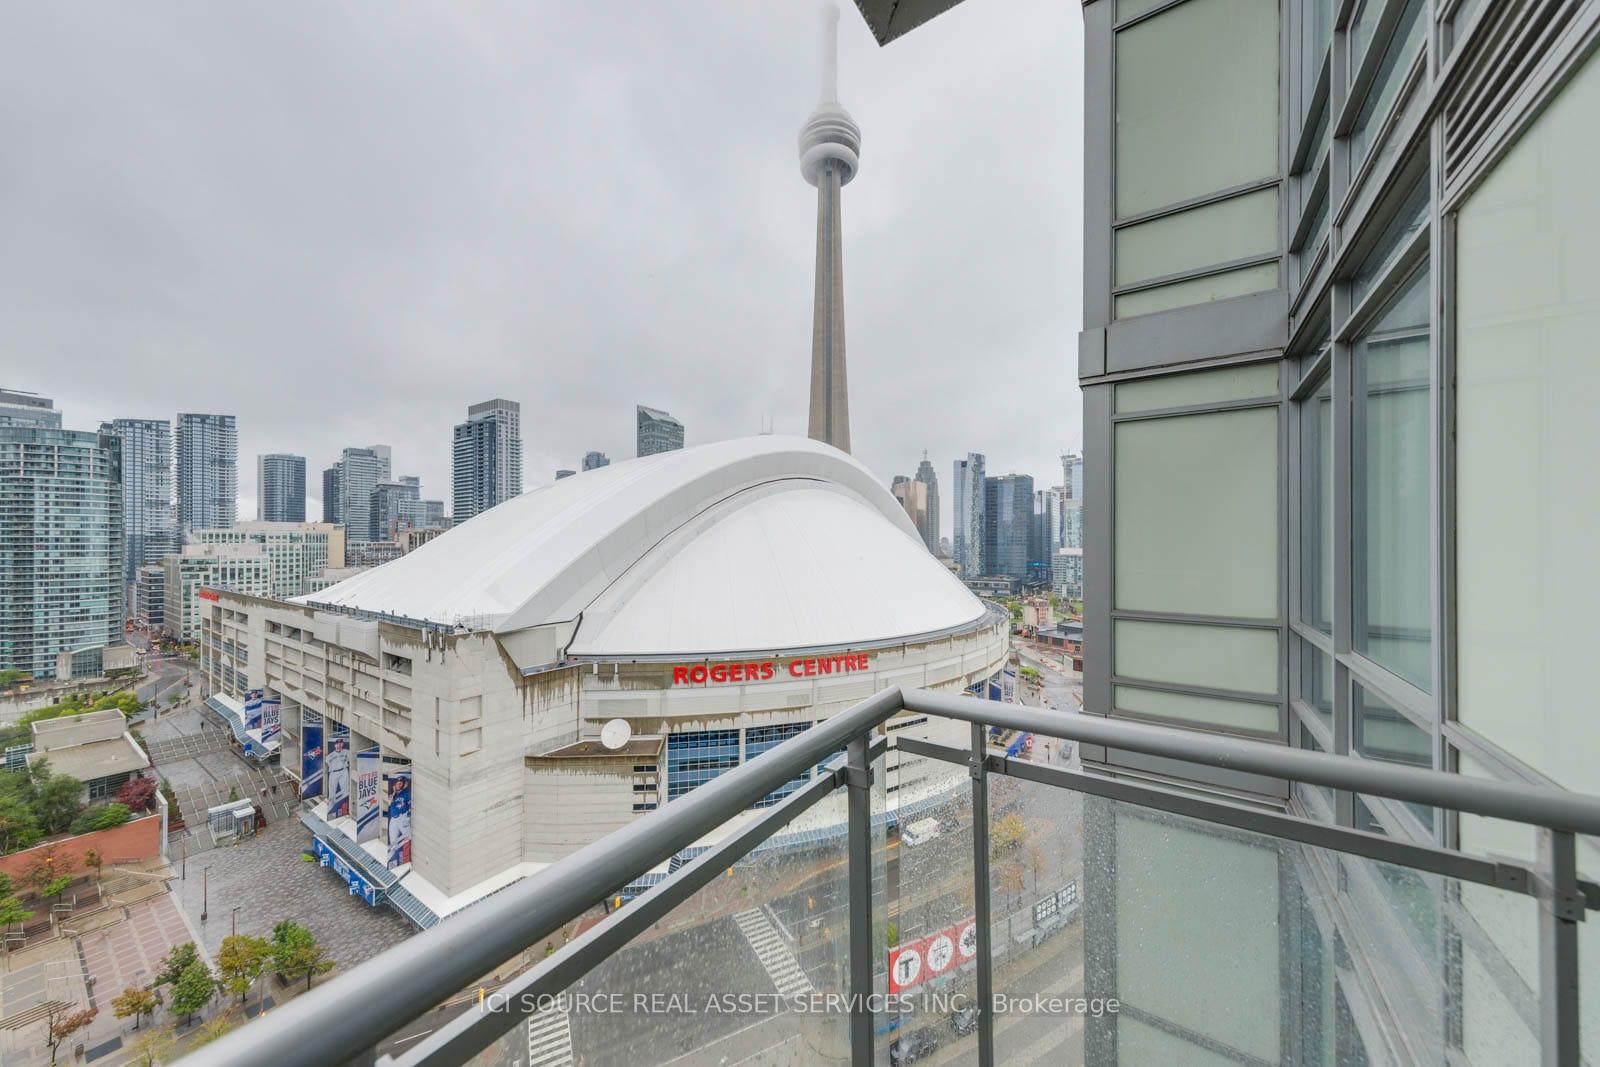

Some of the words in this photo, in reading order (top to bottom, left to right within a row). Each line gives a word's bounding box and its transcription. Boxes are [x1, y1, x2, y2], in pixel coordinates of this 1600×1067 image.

[673, 661, 775, 685] ROGERS
[788, 652, 870, 678] CENTRE
[358, 776, 378, 790] BLUE
[358, 786, 377, 800] JAYS
